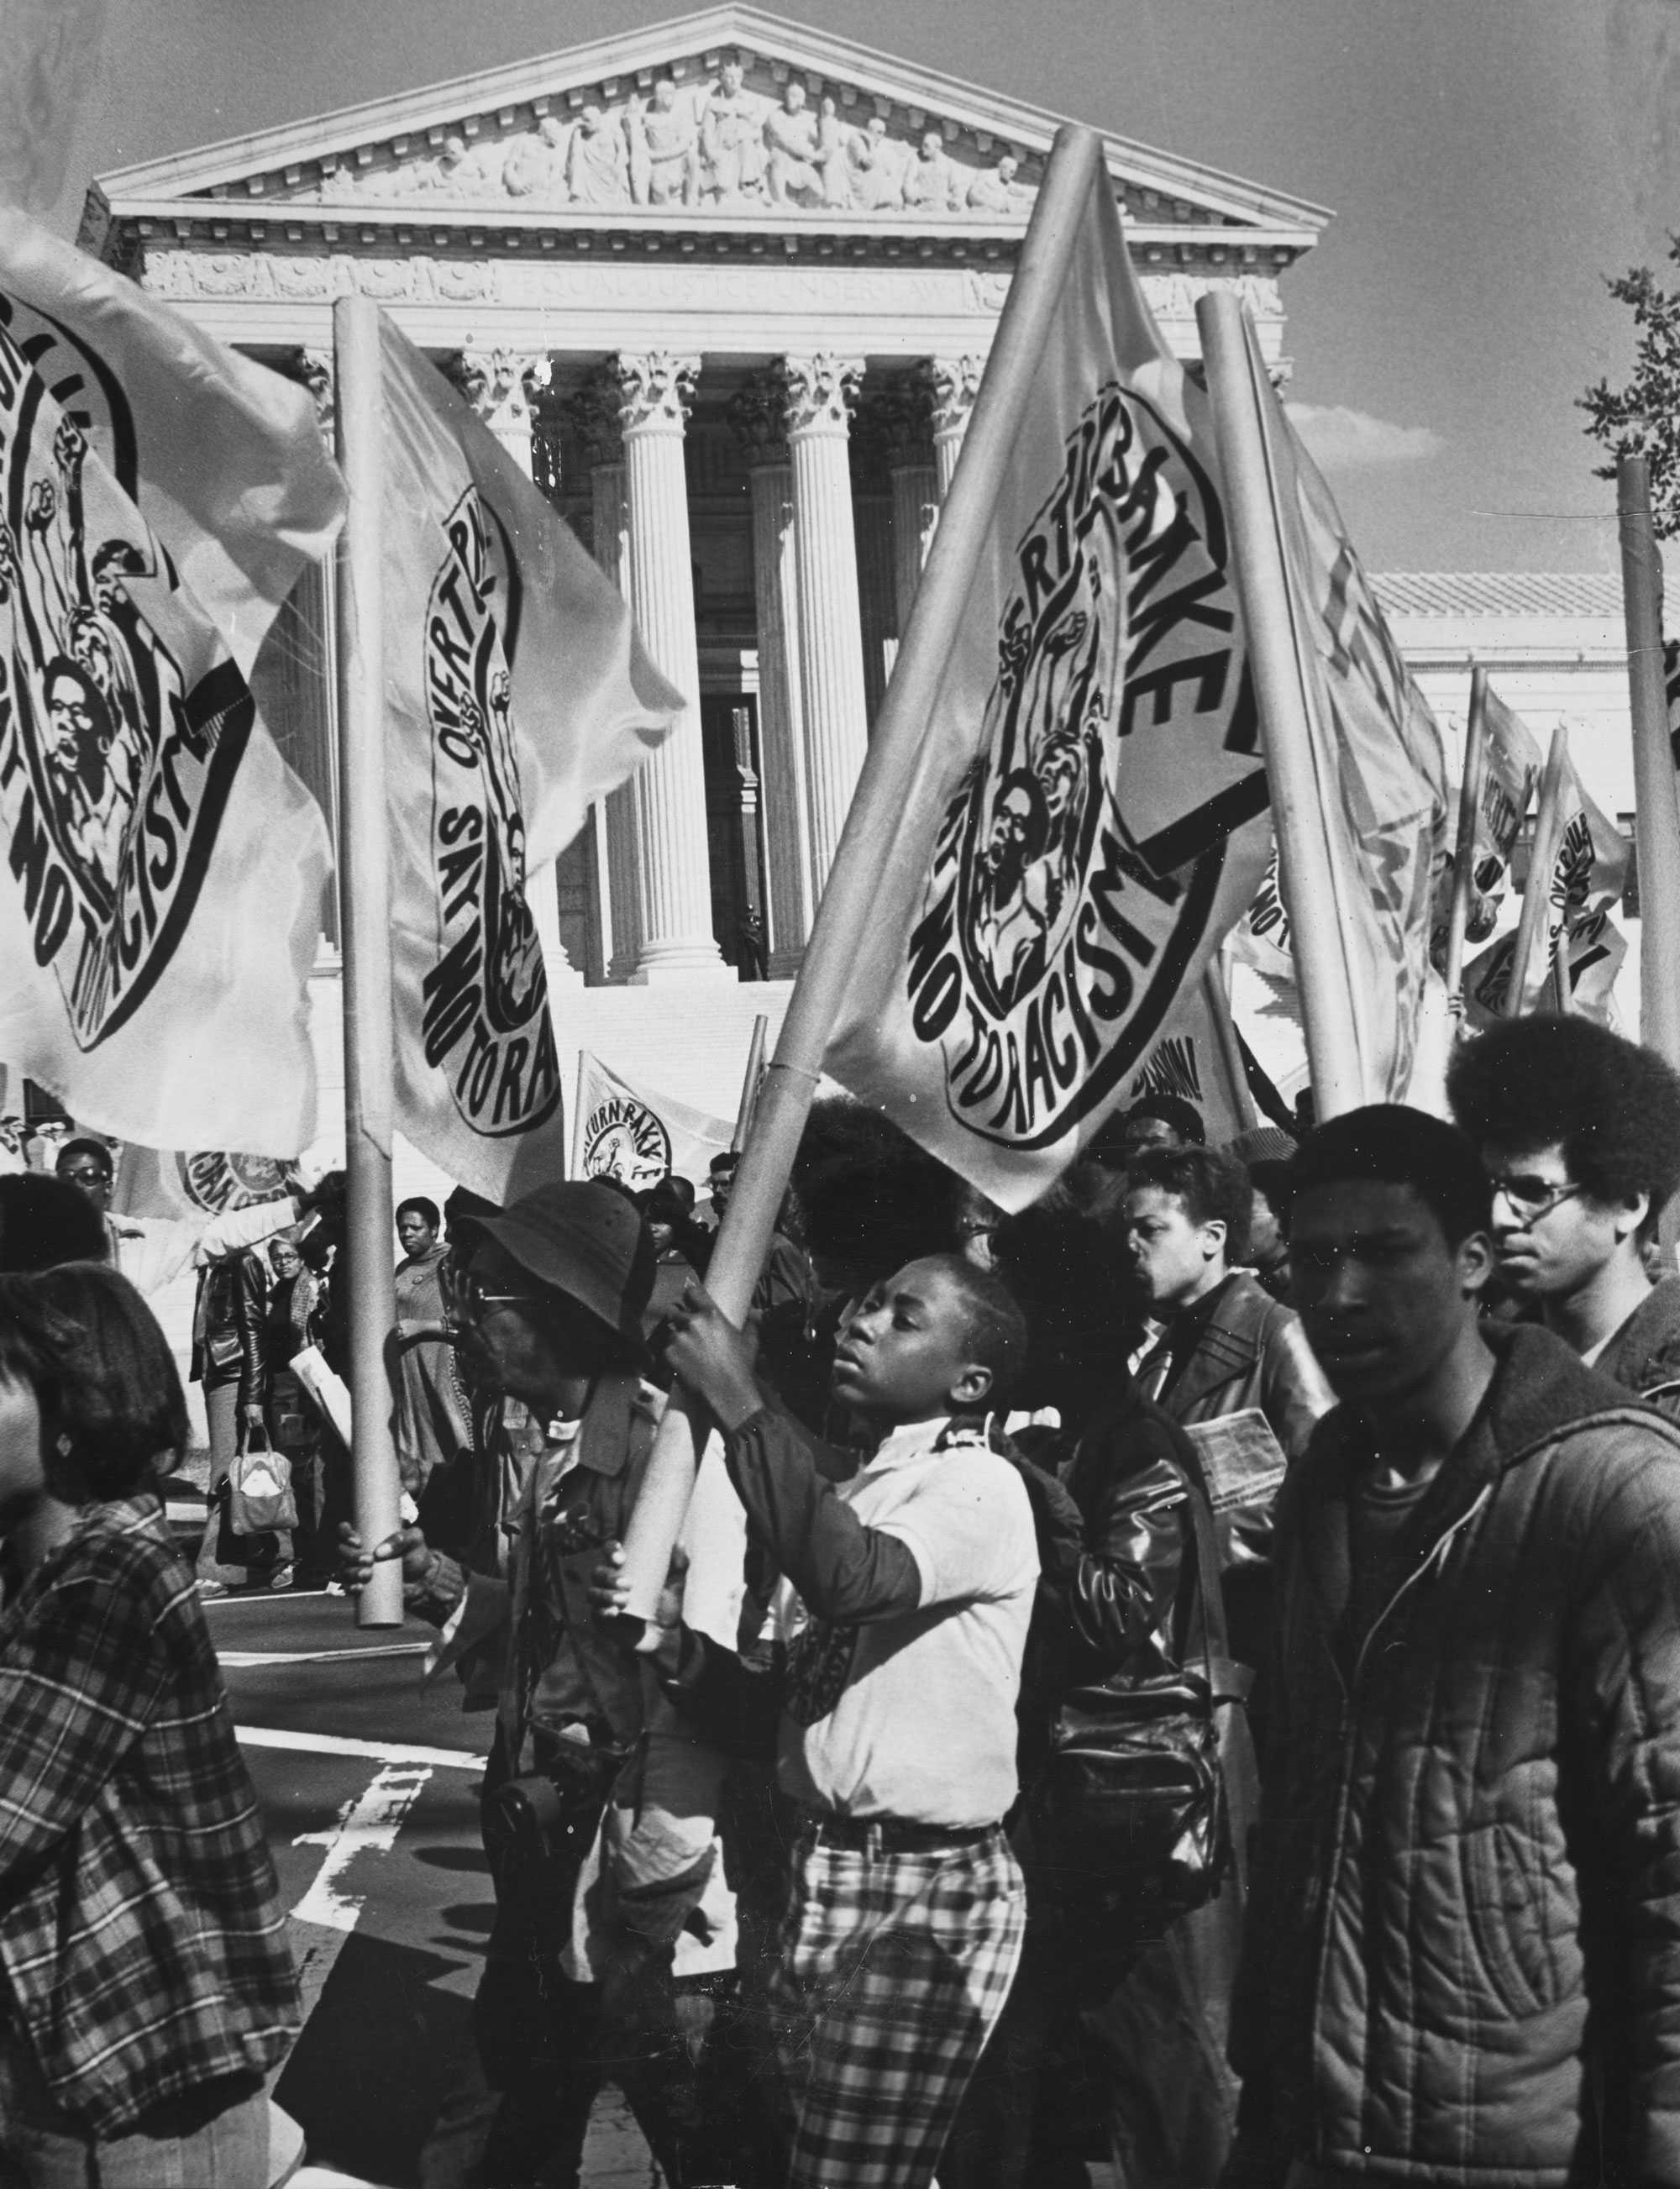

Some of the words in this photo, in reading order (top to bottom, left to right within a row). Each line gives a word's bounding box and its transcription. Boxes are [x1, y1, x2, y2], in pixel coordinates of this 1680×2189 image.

[439, 805, 482, 925] SAY
[423, 914, 482, 1068] NO
[907, 876, 963, 1042] NO
[989, 827, 1176, 1134] RACISM
[456, 1014, 507, 1117] TO
